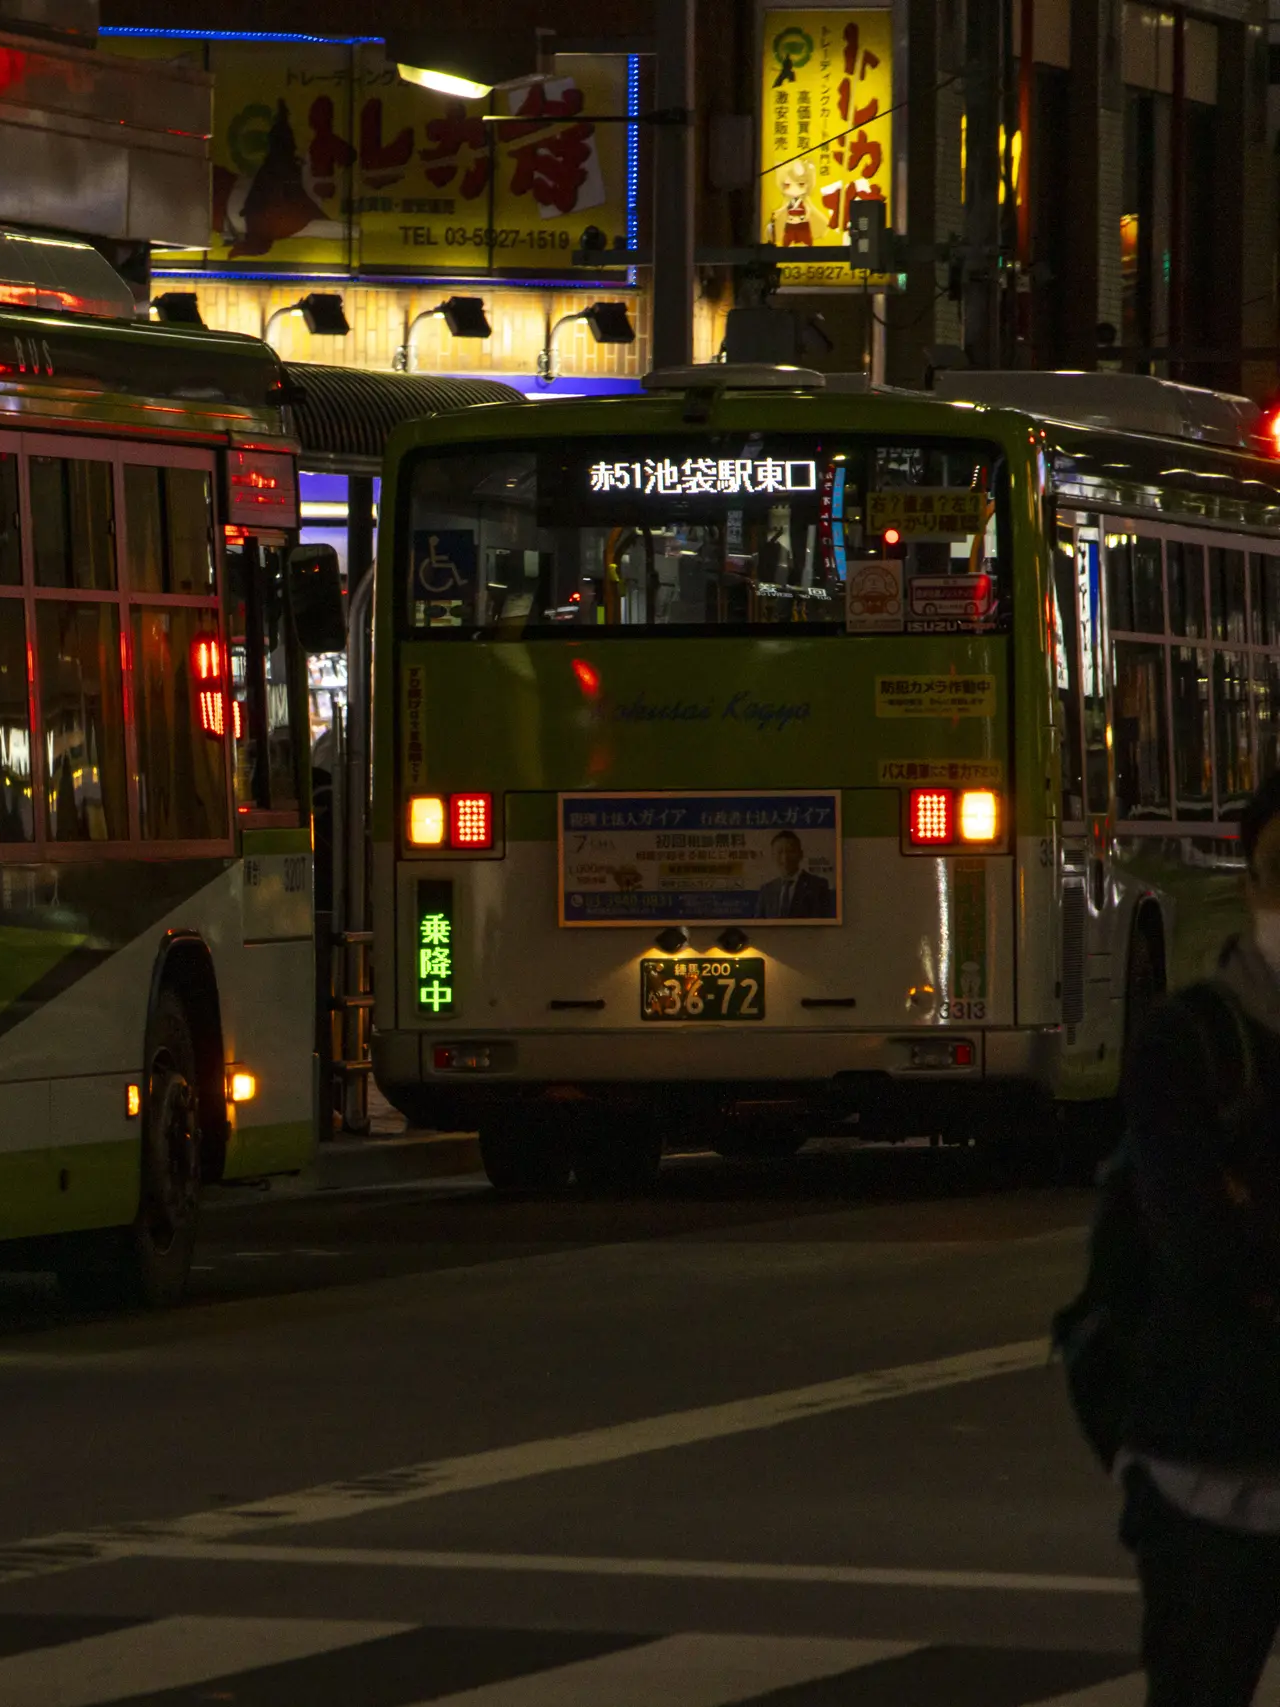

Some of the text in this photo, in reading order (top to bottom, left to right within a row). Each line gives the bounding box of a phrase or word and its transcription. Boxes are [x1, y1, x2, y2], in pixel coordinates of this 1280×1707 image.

[797, 91, 811, 150] 高価買取
[400, 226, 570, 250] TEL 03-5927-1519
[590, 457, 816, 495] 赤51池袋駅東口
[907, 621, 958, 633] ISUZU
[880, 680, 991, 695] 防犯カメラ作動中
[420, 913, 451, 1012] 乗降中
